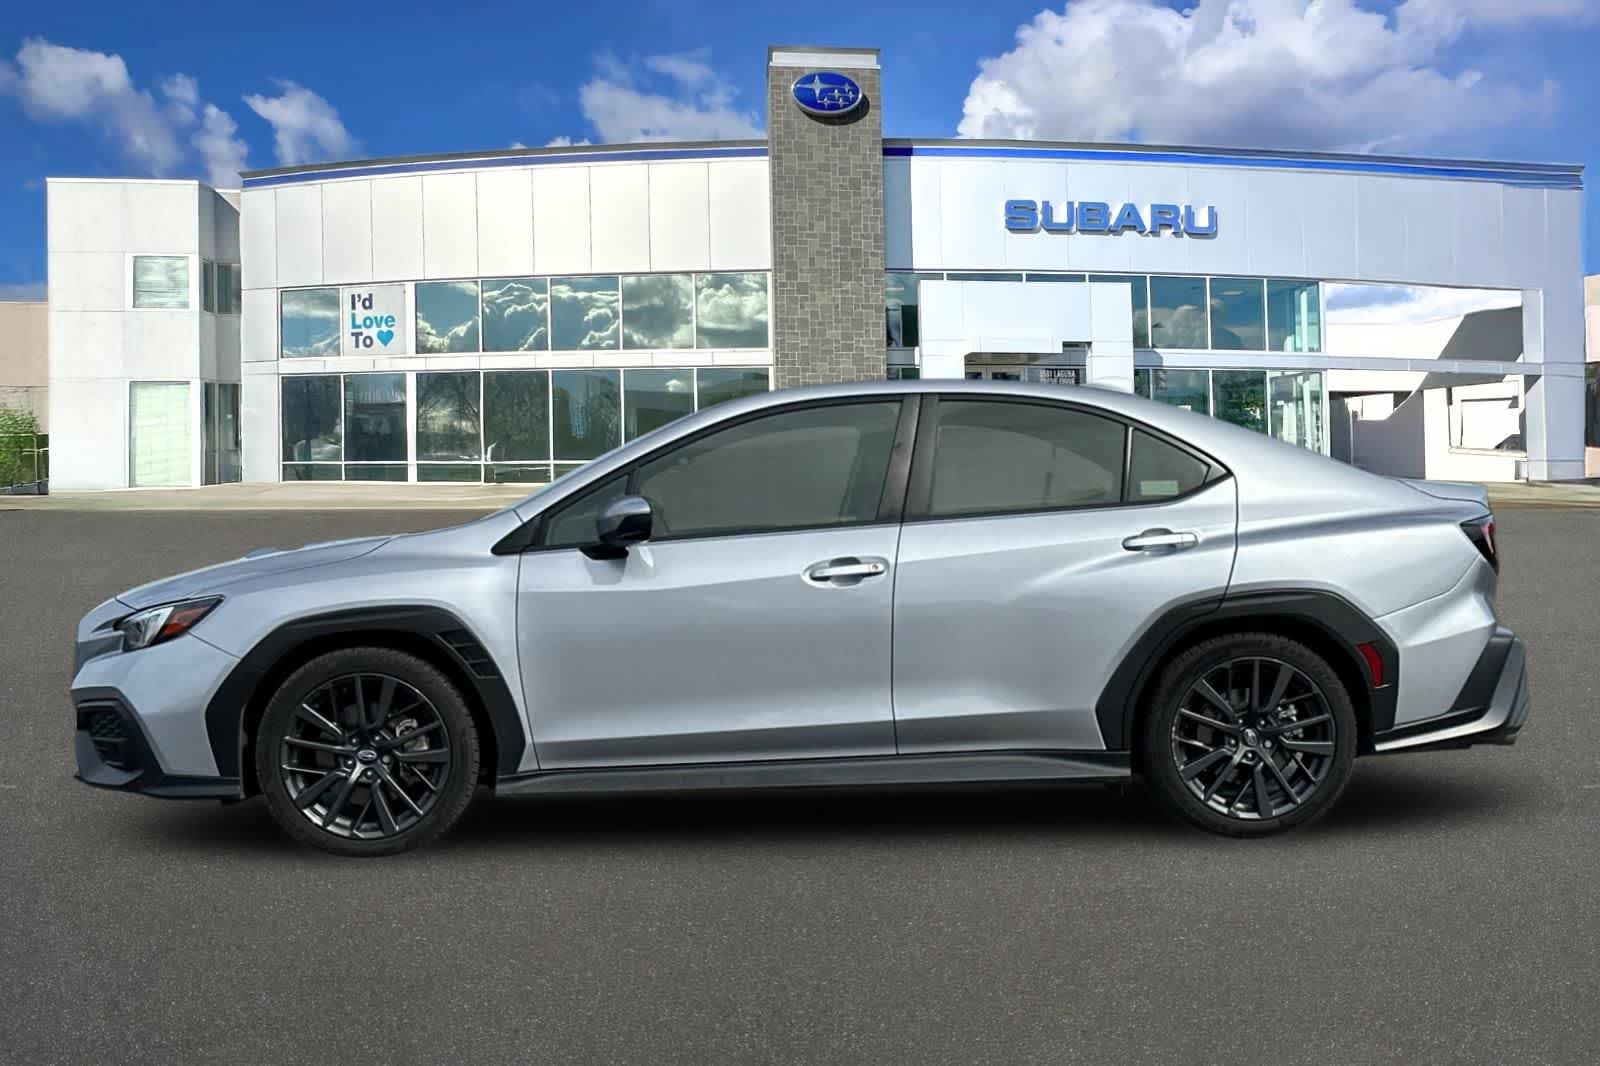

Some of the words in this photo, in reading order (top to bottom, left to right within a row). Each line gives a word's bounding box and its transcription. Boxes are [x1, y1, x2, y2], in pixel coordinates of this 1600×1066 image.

[1005, 199, 1218, 239] SUBARU
[351, 293, 373, 310] I'd
[351, 312, 396, 329] Love
[351, 331, 374, 348] To
